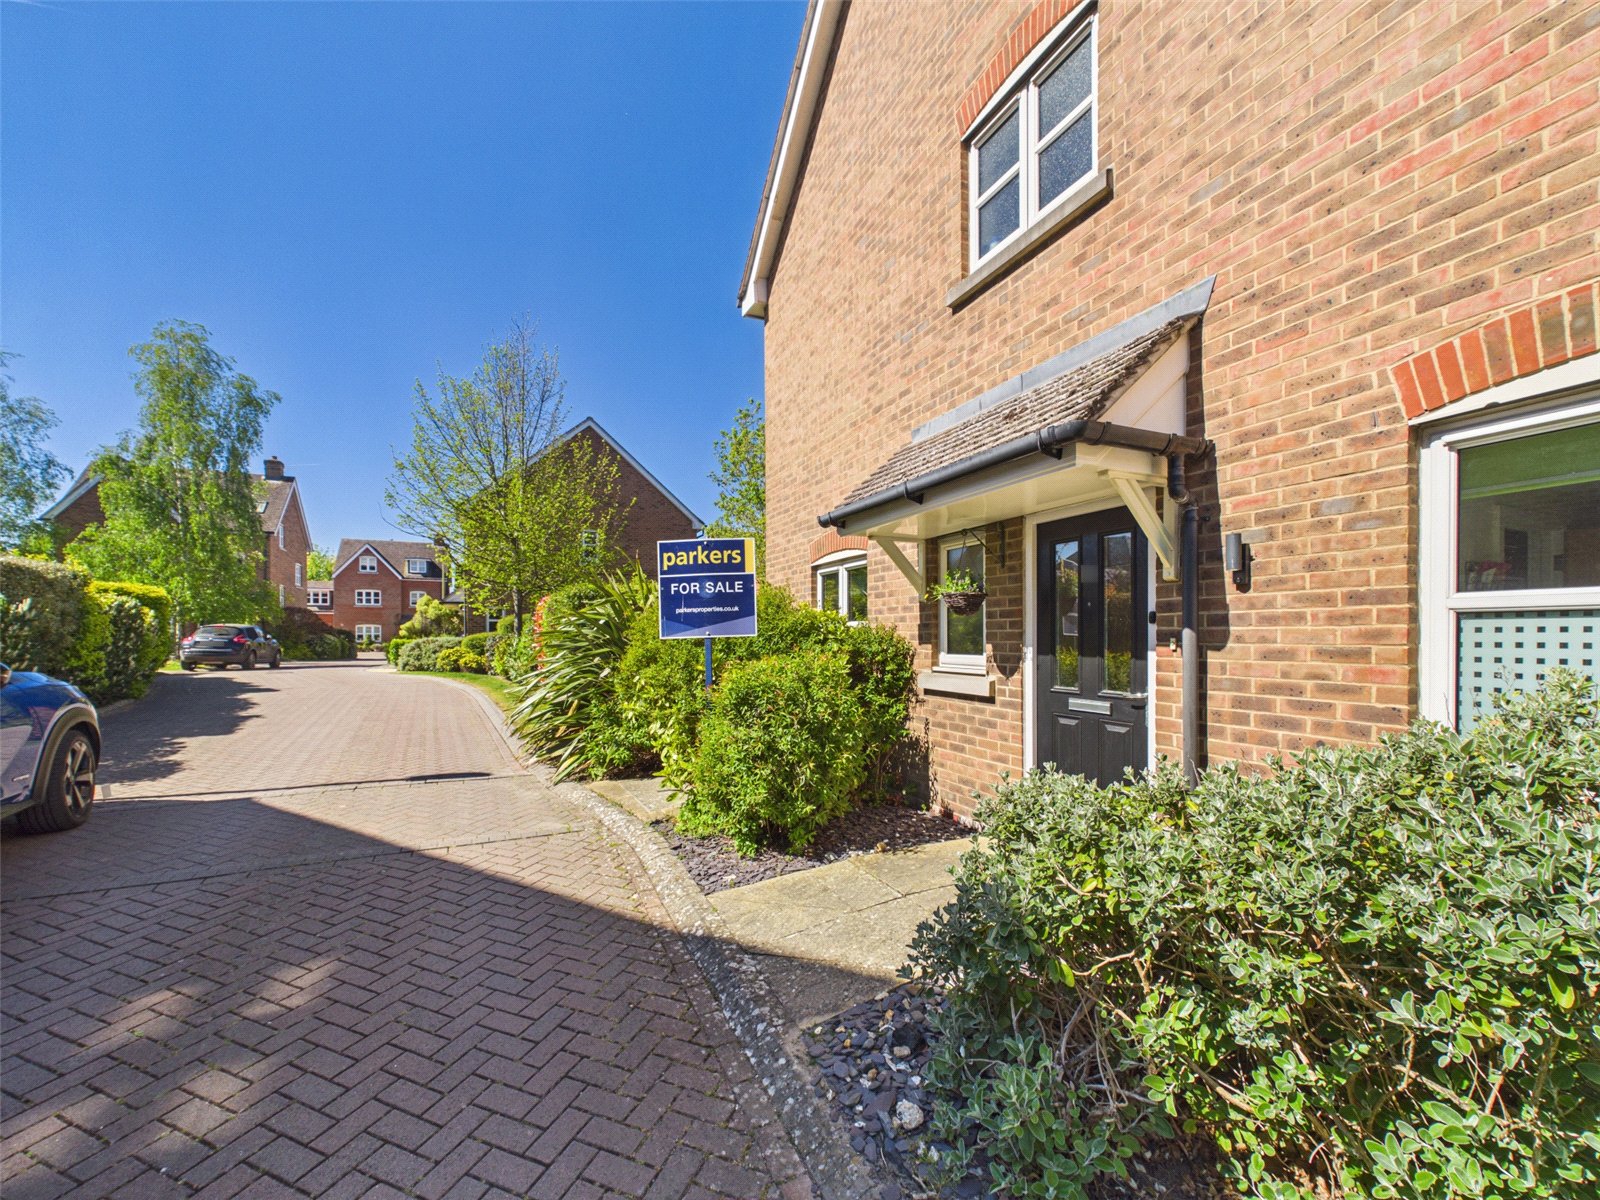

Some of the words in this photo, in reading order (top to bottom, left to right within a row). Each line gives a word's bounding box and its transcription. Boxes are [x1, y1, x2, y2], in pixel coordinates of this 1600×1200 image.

[662, 545, 741, 570] parkers
[670, 583, 700, 594] FOR
[705, 581, 743, 593] SALE
[675, 605, 739, 614] parkersproperties.co.uk
